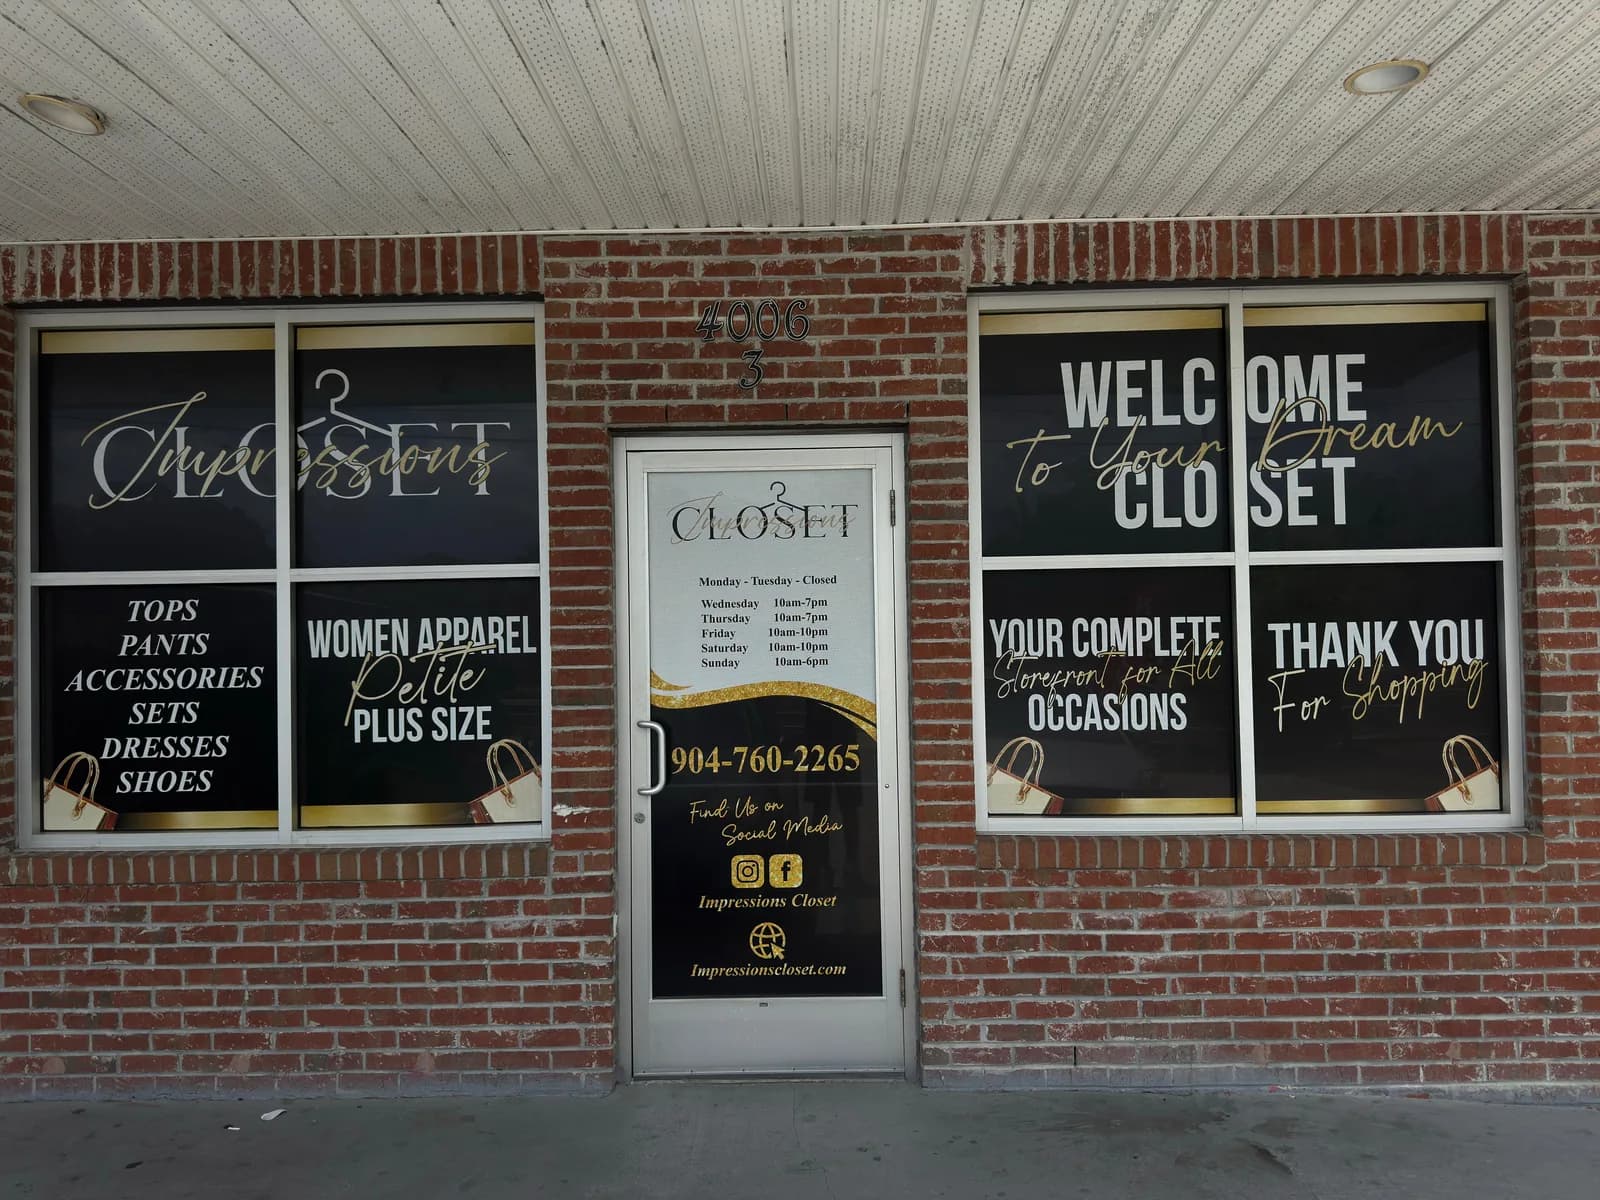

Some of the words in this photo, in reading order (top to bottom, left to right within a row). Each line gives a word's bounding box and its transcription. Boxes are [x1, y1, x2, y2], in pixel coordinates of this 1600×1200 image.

[695, 299, 810, 342] 4006
[738, 349, 764, 390] 3
[1060, 353, 1367, 429] WELCOME
[80, 391, 508, 509] Impressions
[1089, 414, 1226, 490] Your
[1256, 396, 1463, 472] Dream
[92, 421, 510, 500] CLOSET
[1114, 457, 1356, 529] CLOSET
[667, 491, 859, 544] Impressions
[672, 504, 859, 541] CLOSET
[699, 577, 741, 588] Monday
[751, 576, 793, 587] Tuesday
[803, 575, 837, 585] Closed
[128, 599, 199, 623] TOPS
[701, 599, 760, 610] Wednesday
[773, 597, 828, 608] 10am-7pm
[701, 614, 751, 625] Thursday
[774, 612, 828, 623] 10am-7pm
[119, 633, 209, 657] PANTS
[307, 618, 409, 659] WOMEN
[417, 615, 537, 655] APPAREL
[701, 643, 749, 654] Saturday
[768, 642, 829, 653] 10am-10pm
[702, 629, 736, 640] Friday
[768, 627, 828, 638] 10am-10pm
[989, 618, 1064, 658] YOUR
[1072, 616, 1222, 657] COMPLETE
[1267, 620, 1400, 669] THANK
[1408, 619, 1484, 666] YOU
[64, 666, 264, 692] ACCESSORIES
[701, 658, 740, 669] Sunday
[775, 657, 829, 668] 10am-6pm
[993, 645, 1127, 710] Storefront
[1118, 665, 1162, 705] for
[1169, 638, 1225, 689] All
[344, 641, 497, 727] Petite
[1267, 669, 1331, 733] For
[1342, 651, 1489, 724] Shopping
[128, 702, 200, 726] SETS
[353, 707, 424, 743] PLUS
[431, 705, 493, 742] SIZE
[1028, 692, 1188, 731] OCCASIONS
[100, 735, 229, 760] DRESSES
[671, 744, 861, 774] 904-760-2265
[115, 770, 213, 794] SHOES
[689, 798, 728, 825] Find
[735, 796, 758, 818] Us
[764, 801, 784, 812] on
[721, 820, 776, 846] Social
[783, 815, 843, 840] Media
[698, 894, 787, 912] Impressions
[791, 893, 837, 908] Closet
[690, 962, 847, 980] Impressionscloset.com
